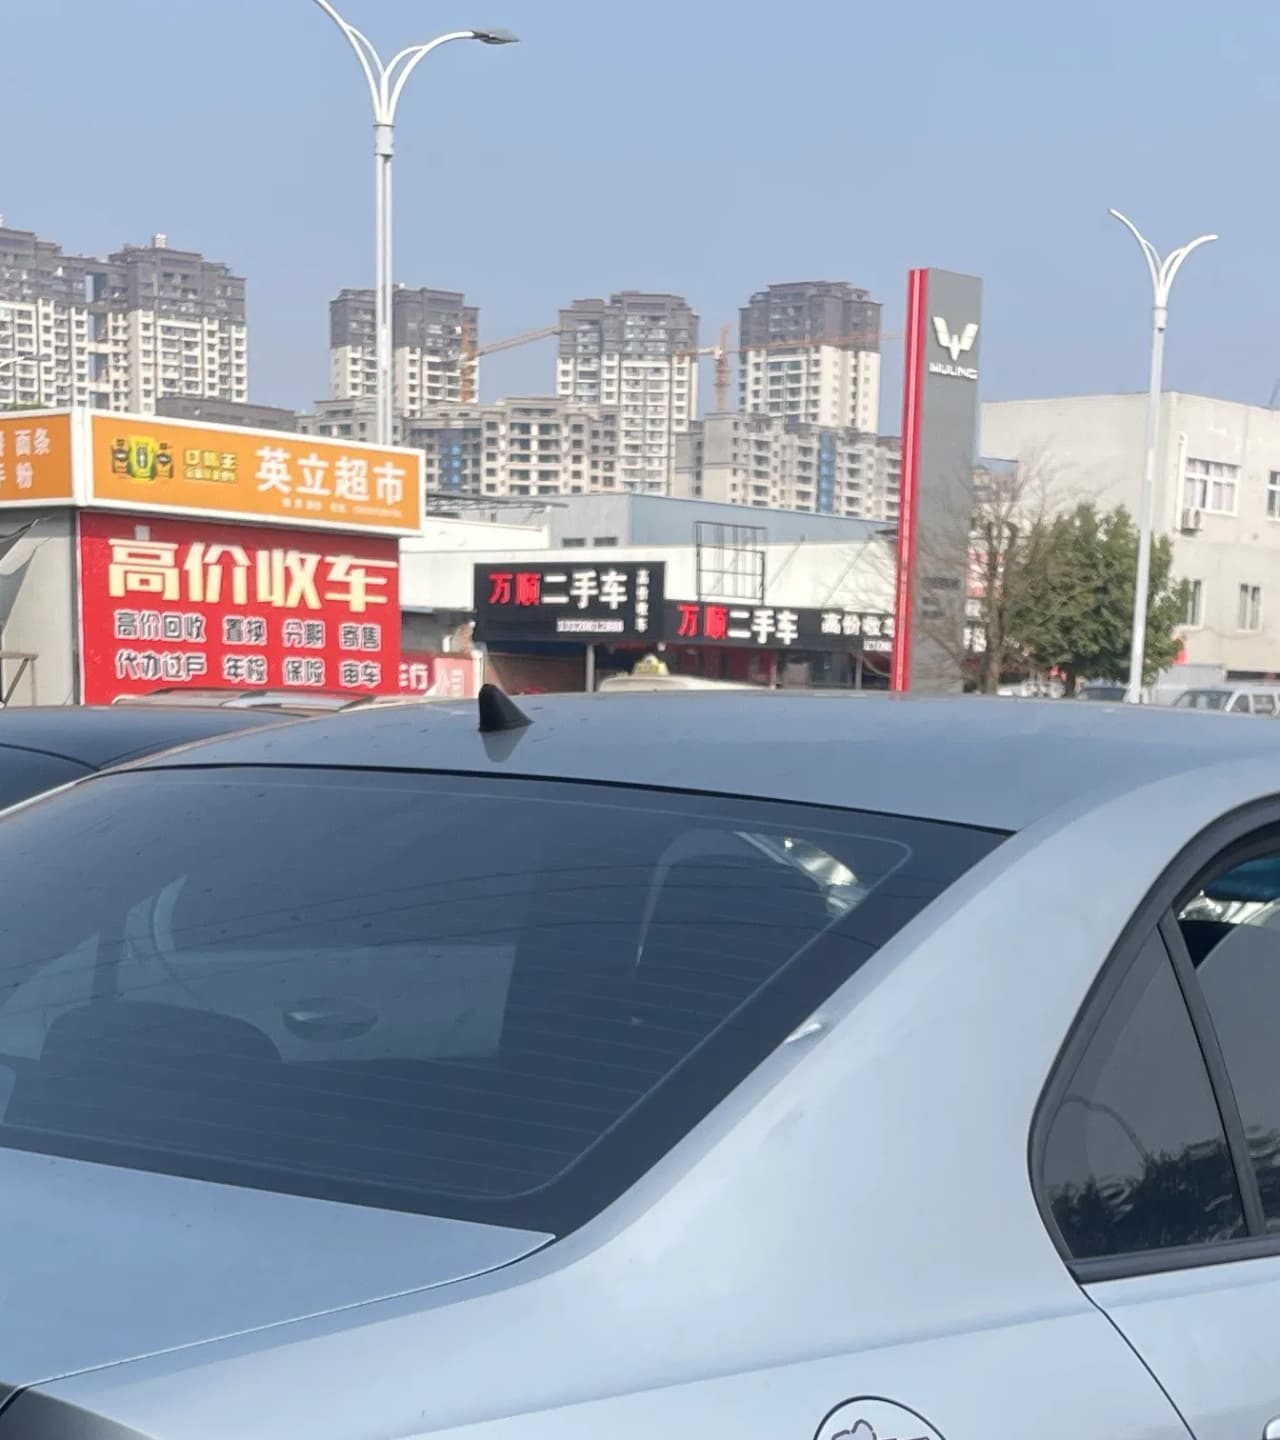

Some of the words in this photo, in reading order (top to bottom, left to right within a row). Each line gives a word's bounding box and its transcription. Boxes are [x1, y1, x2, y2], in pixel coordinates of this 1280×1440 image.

[14, 427, 51, 456] 面条
[254, 445, 407, 506] 英立超市
[108, 537, 398, 613] 高价收车
[488, 570, 628, 610] 万顺二手车
[114, 609, 207, 644] 高价回收
[222, 614, 268, 647] 置换
[281, 618, 326, 648] 分期
[338, 622, 383, 652] 寄售
[677, 603, 799, 645] 万顺二手车
[114, 648, 208, 683] 代办过户
[281, 656, 326, 687] 保险
[338, 660, 383, 689] 审车
